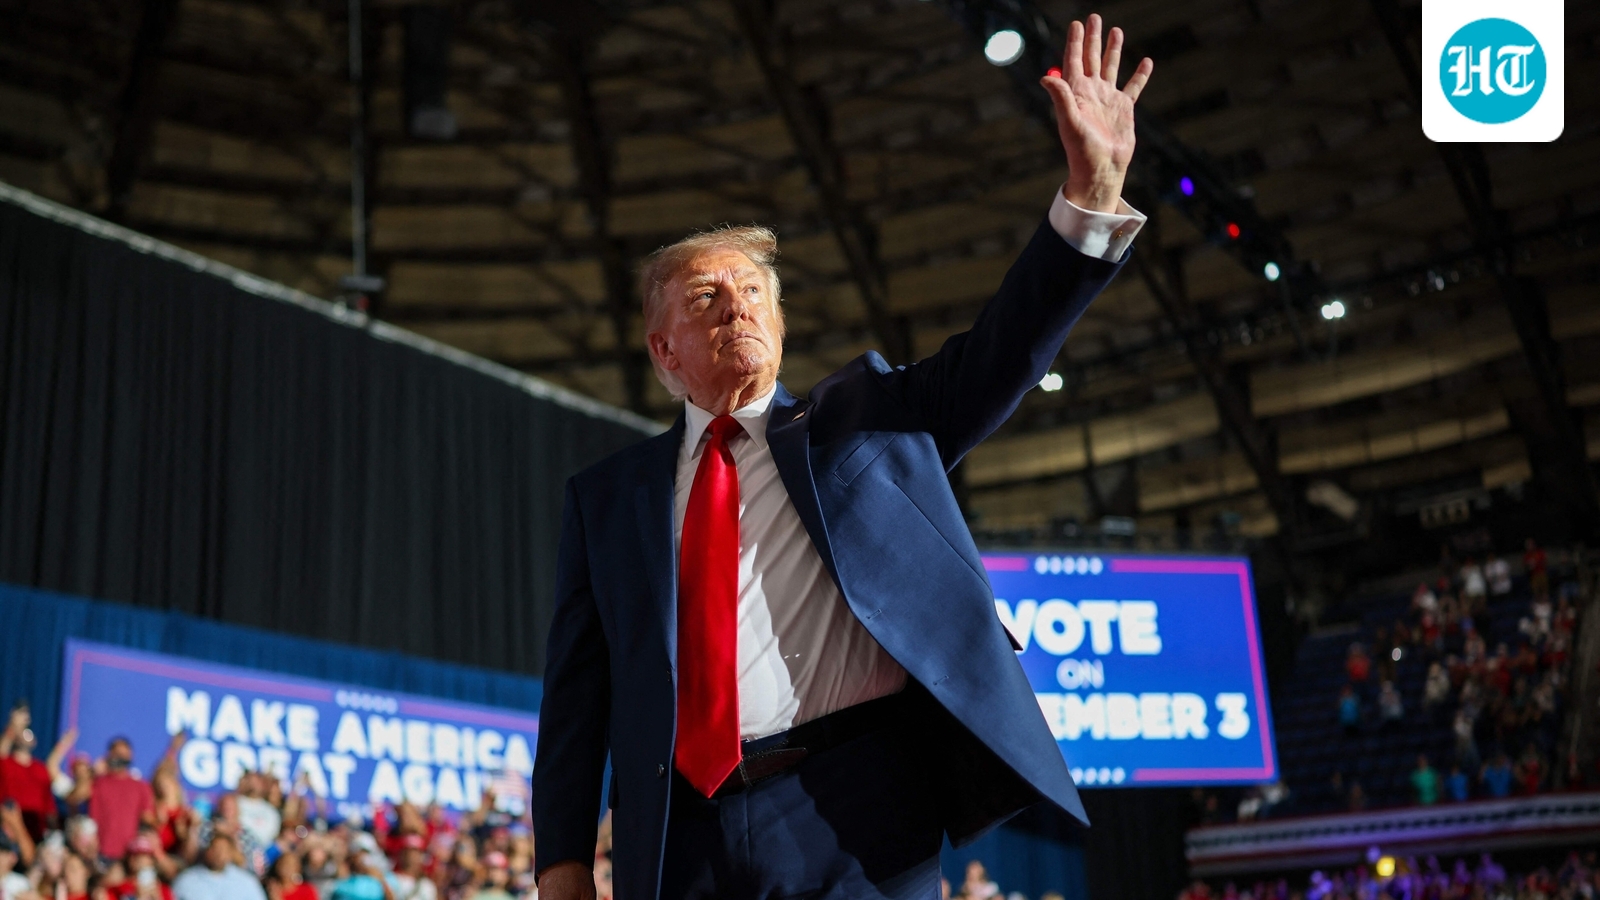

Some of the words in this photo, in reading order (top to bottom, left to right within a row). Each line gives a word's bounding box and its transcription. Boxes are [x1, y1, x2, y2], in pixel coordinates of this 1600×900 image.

[994, 599, 1163, 655] VOTE
[1056, 658, 1104, 690] ON
[166, 686, 319, 752] MAKE
[331, 711, 534, 777] AMERICA
[1215, 692, 1250, 740] 3
